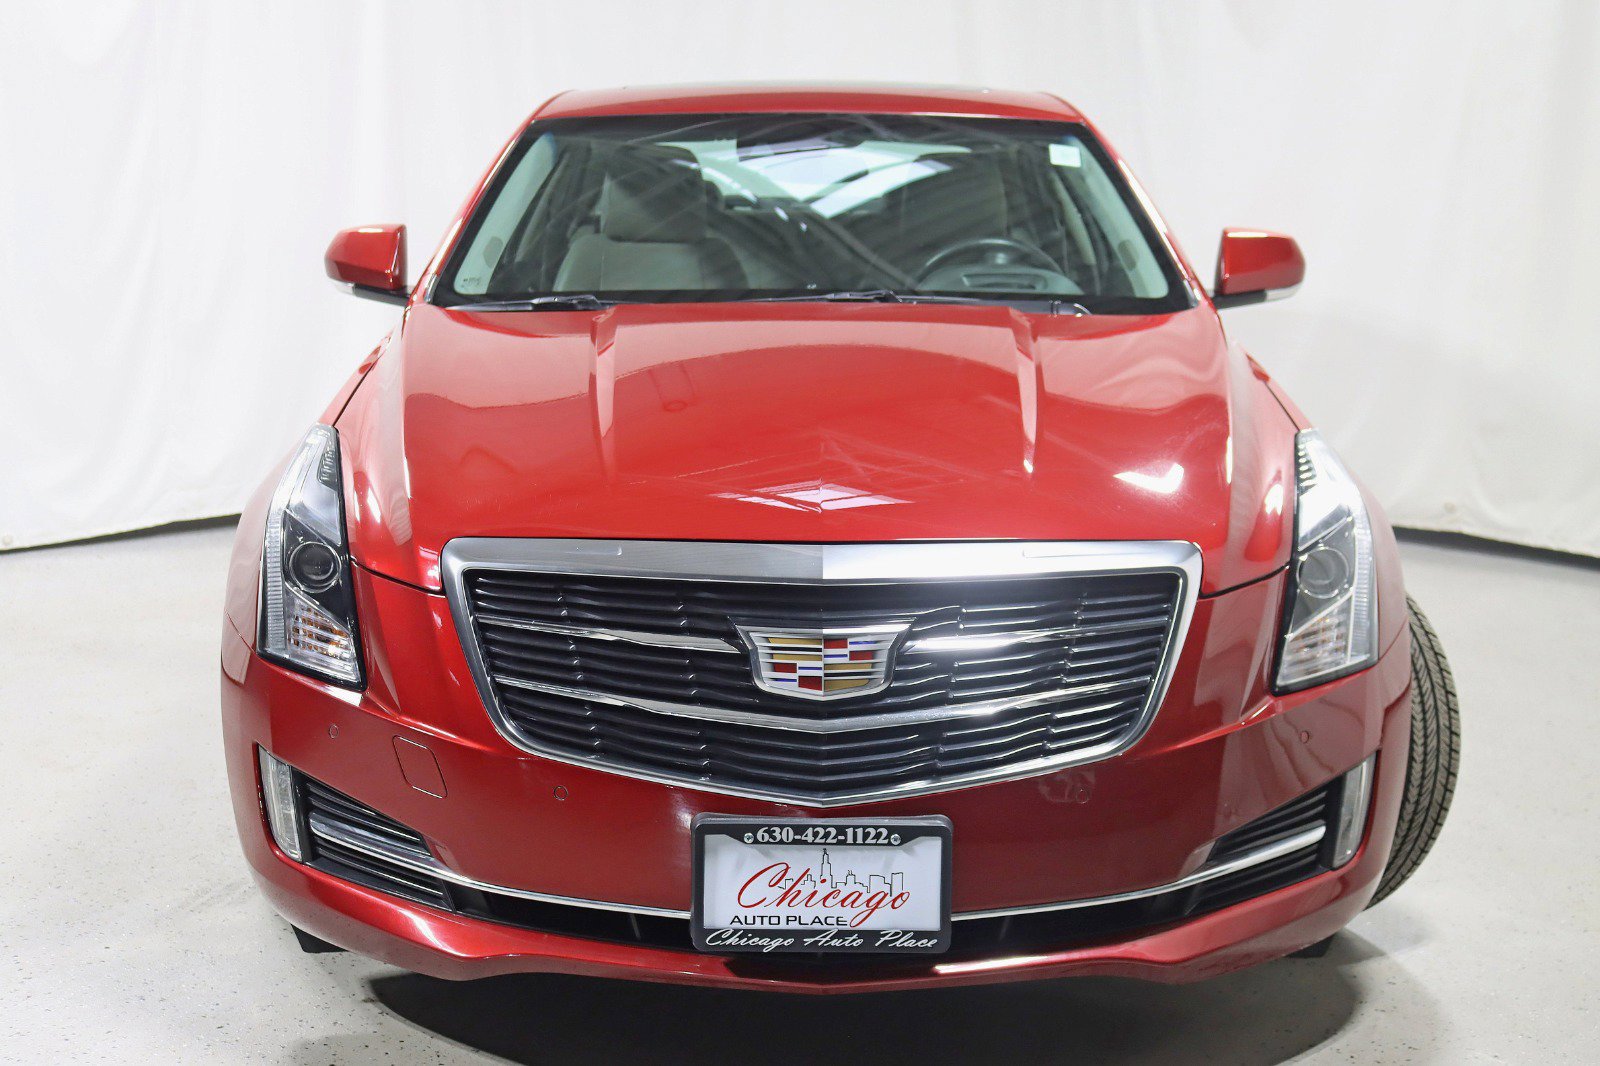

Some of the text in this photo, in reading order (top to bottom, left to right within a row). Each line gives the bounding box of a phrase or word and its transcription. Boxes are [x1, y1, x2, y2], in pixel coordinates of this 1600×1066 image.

[756, 827, 889, 844] 630-422-1122
[737, 862, 911, 928] Chicago
[730, 915, 848, 926] AUTO PLACE
[706, 928, 939, 952] Chicago Auto Place
